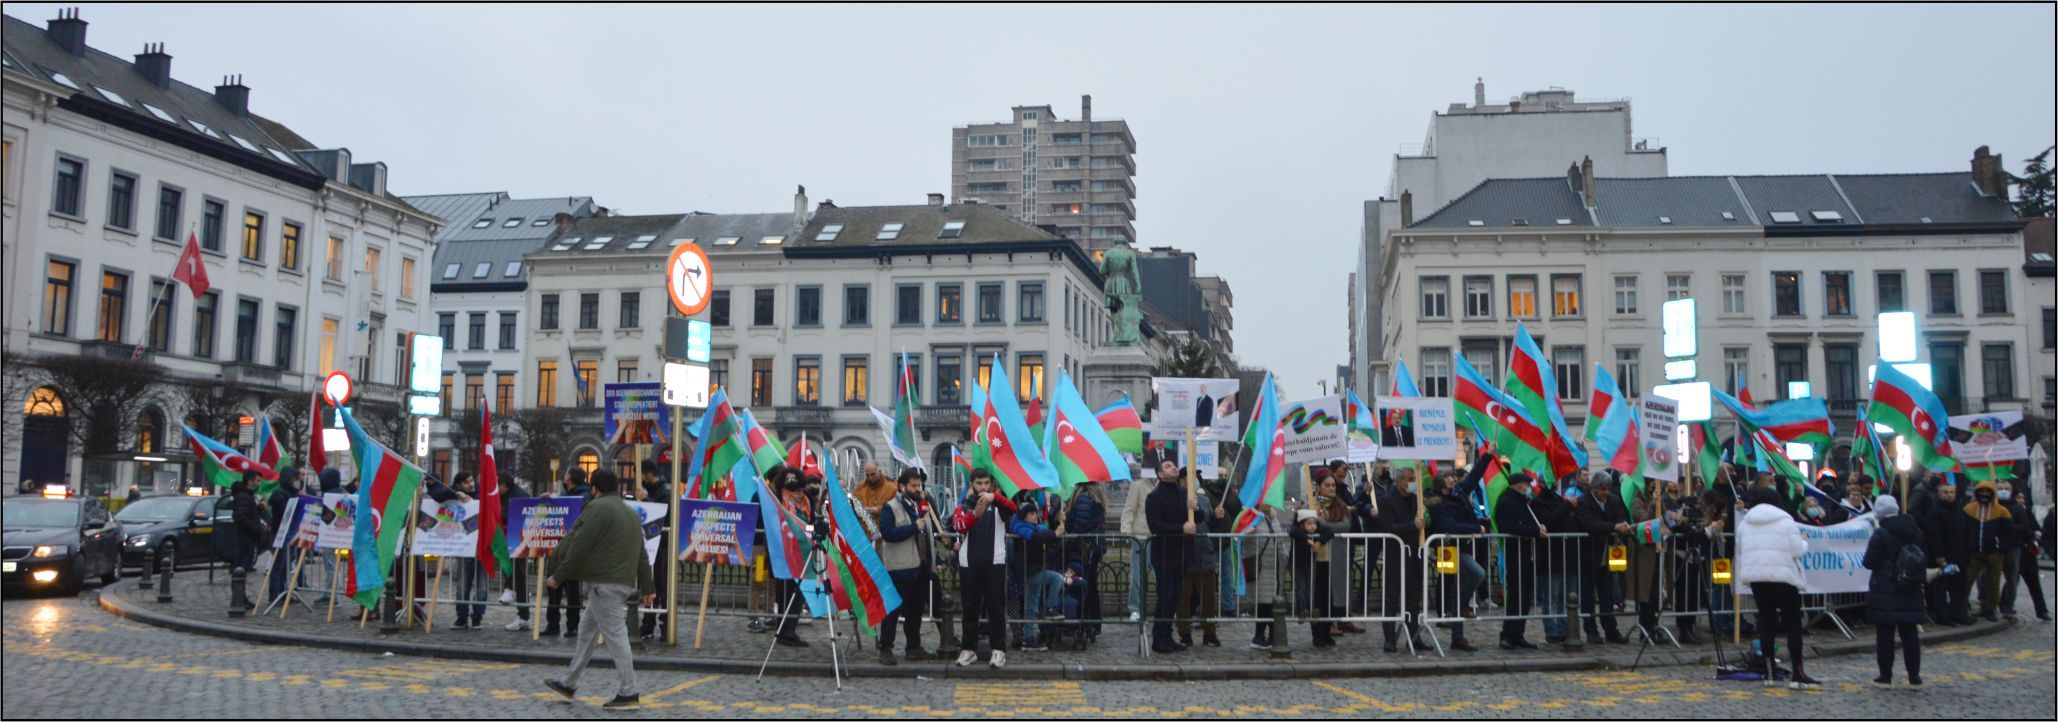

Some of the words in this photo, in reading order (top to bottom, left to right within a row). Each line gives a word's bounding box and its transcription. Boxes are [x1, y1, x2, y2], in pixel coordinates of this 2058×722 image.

[522, 506, 569, 514] AZERBAIJAN
[692, 510, 742, 520] AZERBAIJAN
[525, 517, 564, 526] RESPECTS
[695, 520, 736, 532] RESPECTS
[522, 528, 563, 536] UNIVERSAL
[691, 532, 736, 543] UNIVERSAL
[696, 544, 728, 554] VALUES!
[1802, 550, 1844, 570] come
